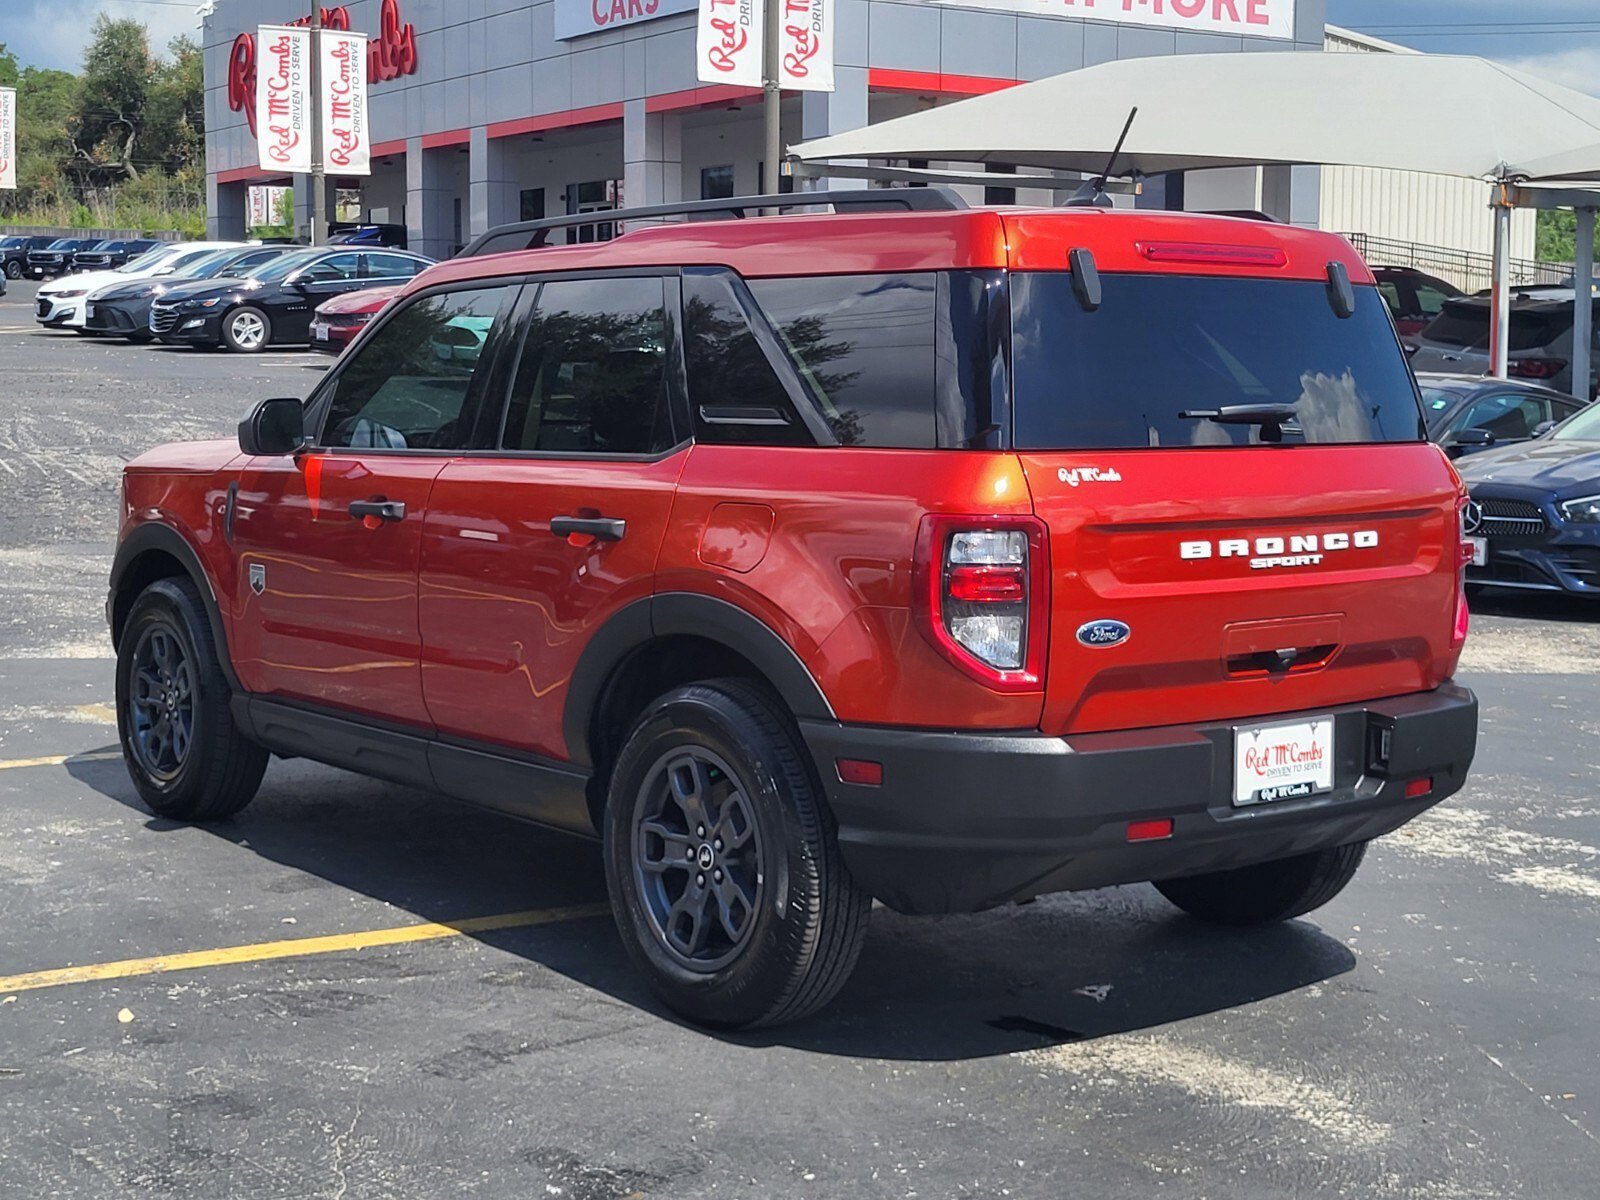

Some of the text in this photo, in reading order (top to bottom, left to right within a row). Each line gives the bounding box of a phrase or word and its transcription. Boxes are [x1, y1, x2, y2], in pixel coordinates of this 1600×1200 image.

[739, 0, 750, 26] DRI
[812, 0, 821, 32] DRIV
[708, 17, 747, 72] Red
[783, 25, 819, 78] Red
[291, 36, 301, 130] DRIVEN TO SERVE
[350, 41, 360, 133] DRIVEN TO SERVE
[3, 119, 10, 130] TO
[268, 125, 299, 162] Red
[330, 129, 359, 166] Red
[1180, 531, 1379, 559] BRONCO
[1250, 554, 1324, 569] SPORT
[1090, 626, 1120, 642] Ford
[1245, 747, 1270, 776] Red
[1266, 760, 1323, 777] DRIVEN TO SERVE
